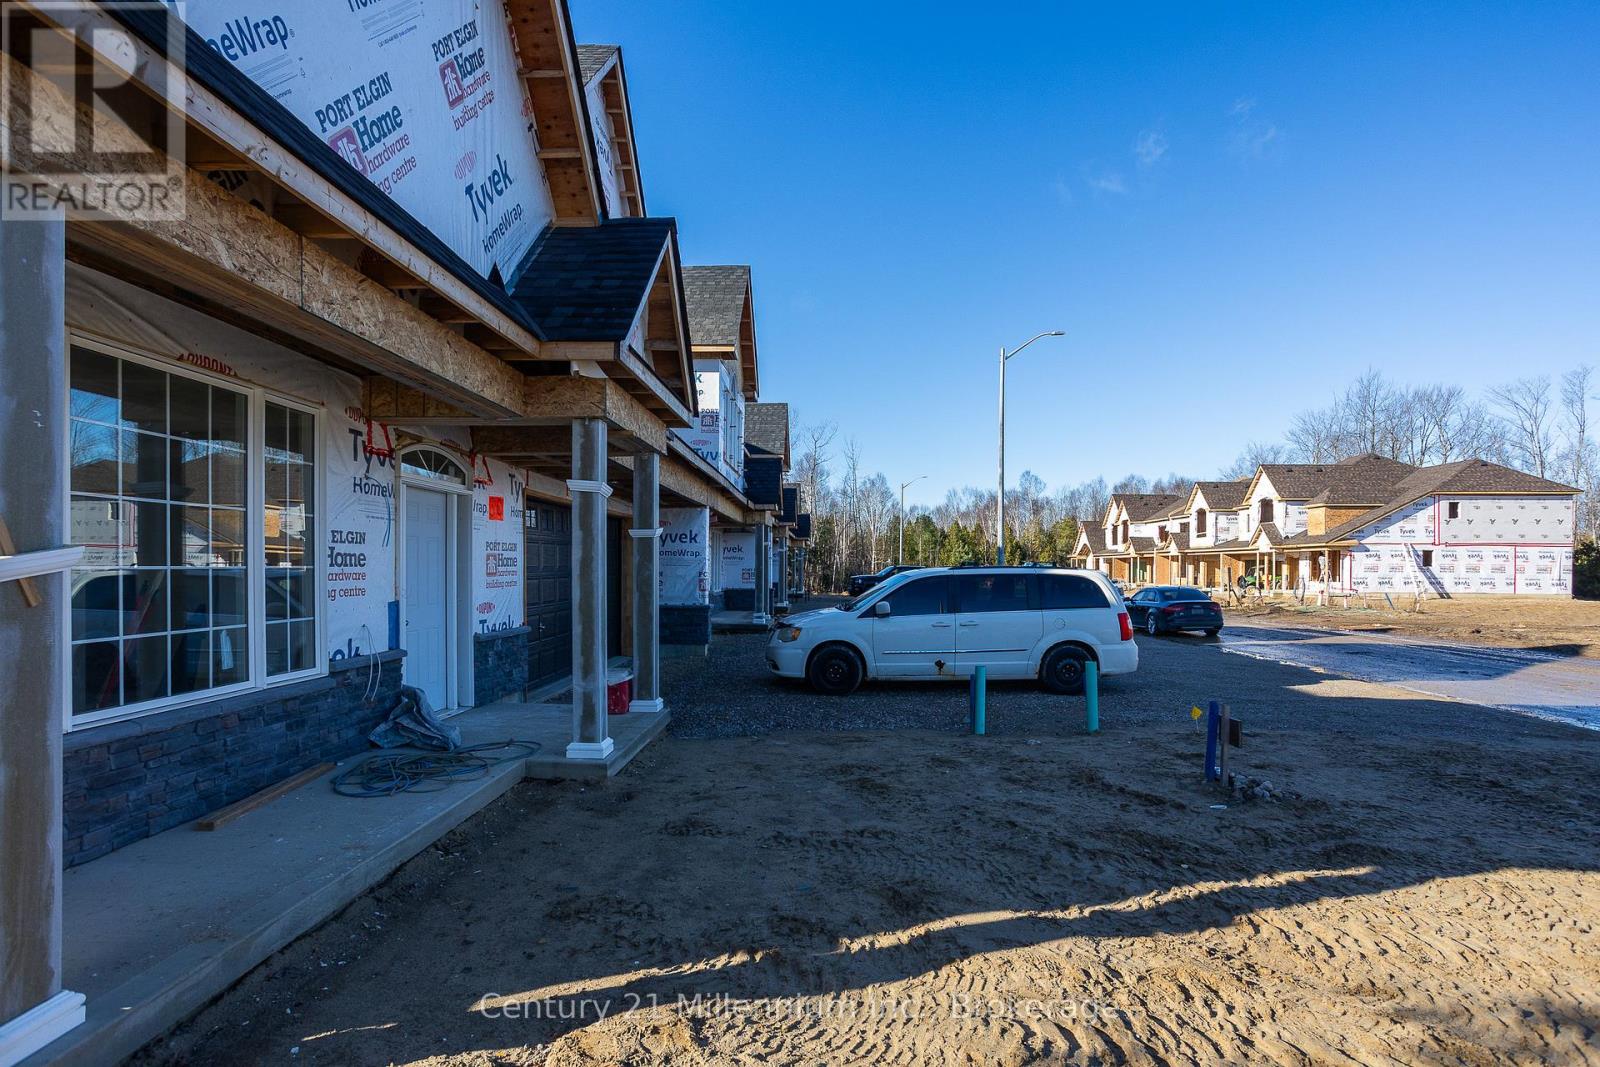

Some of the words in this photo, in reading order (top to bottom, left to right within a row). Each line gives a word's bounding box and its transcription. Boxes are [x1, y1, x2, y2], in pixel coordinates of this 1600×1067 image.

[206, 15, 289, 61] eWrap
[431, 34, 455, 62] PORT
[456, 19, 479, 50] ELGIN
[454, 47, 486, 82] Home
[464, 71, 491, 100] hardware
[315, 93, 354, 133] PORT
[352, 71, 393, 112] ELGIN
[451, 101, 478, 132] building
[477, 90, 496, 111] centre
[352, 105, 404, 153] Home
[365, 133, 410, 174] hardware
[391, 155, 417, 184] centre
[464, 153, 513, 225] Tyvek
[482, 203, 523, 255] HomeWrap
[330, 529, 367, 545] ELGIN
[485, 541, 500, 552] PORT
[501, 542, 518, 552] ELGIN
[660, 529, 699, 548] yvek
[723, 544, 743, 555] yvek
[497, 553, 518, 568] Home
[660, 546, 702, 559] omeWrap
[328, 568, 367, 582] ardware
[338, 585, 366, 598] centre
